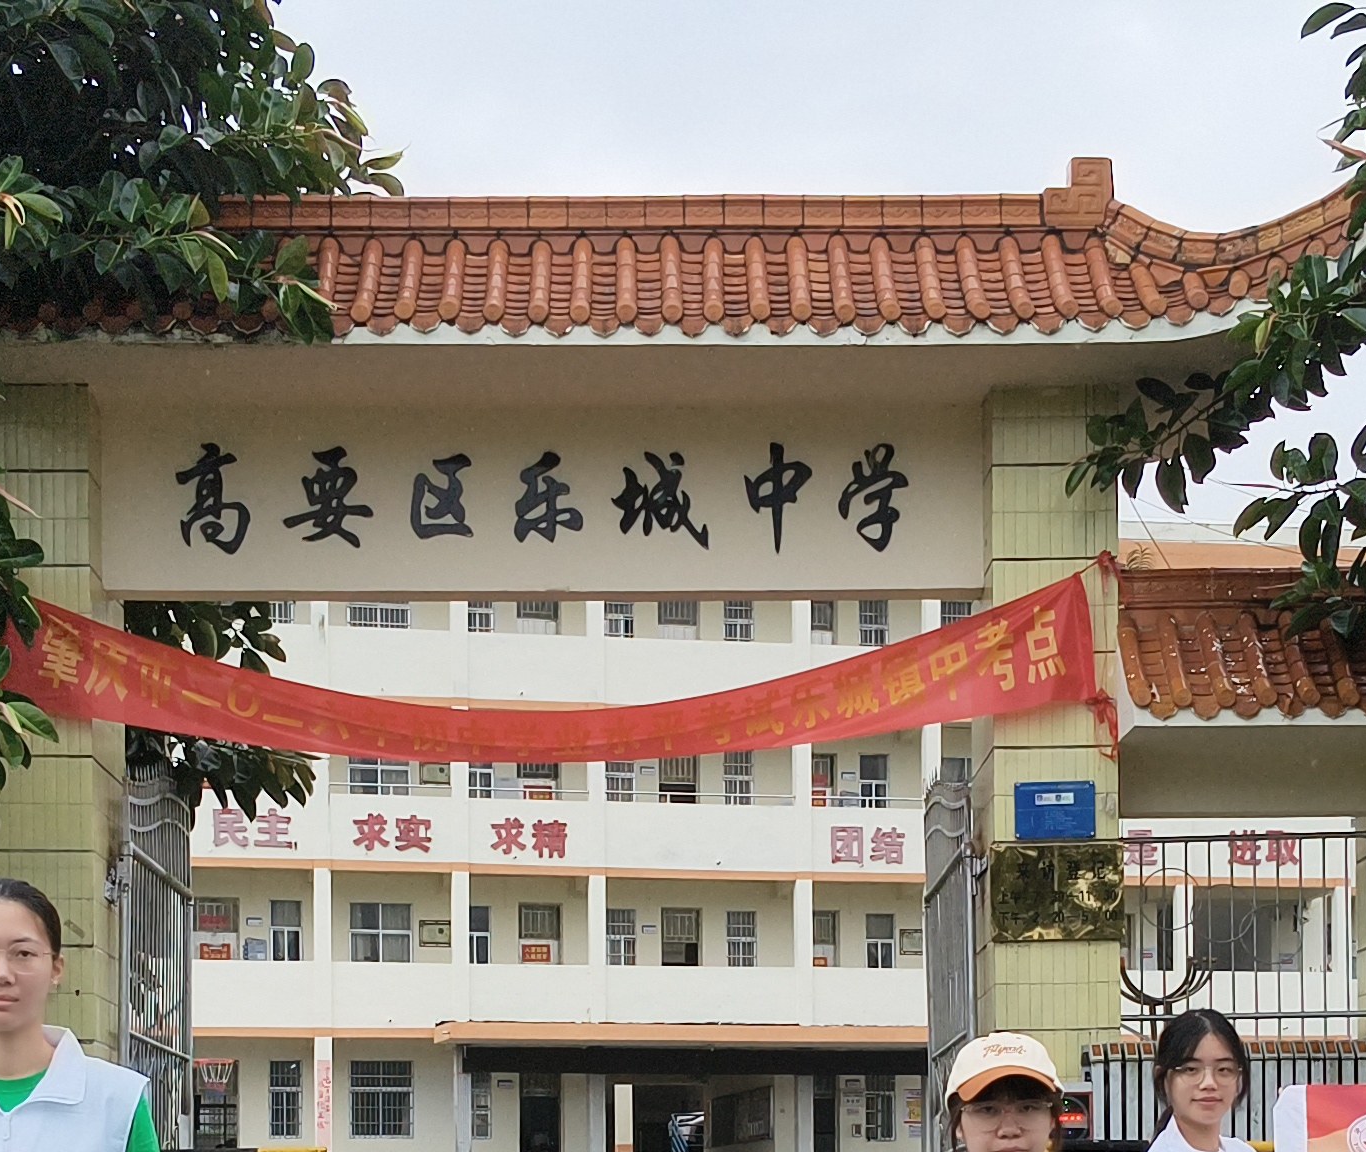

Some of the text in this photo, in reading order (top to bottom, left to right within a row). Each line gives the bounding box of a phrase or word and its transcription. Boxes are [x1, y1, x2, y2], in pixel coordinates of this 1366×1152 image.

[175, 442, 910, 554] 高要区乐城中学
[212, 807, 293, 850] 民主
[352, 813, 433, 853] 求实
[490, 817, 568, 859] 求精
[830, 826, 906, 865] 团结
[1228, 829, 1299, 866] 进取
